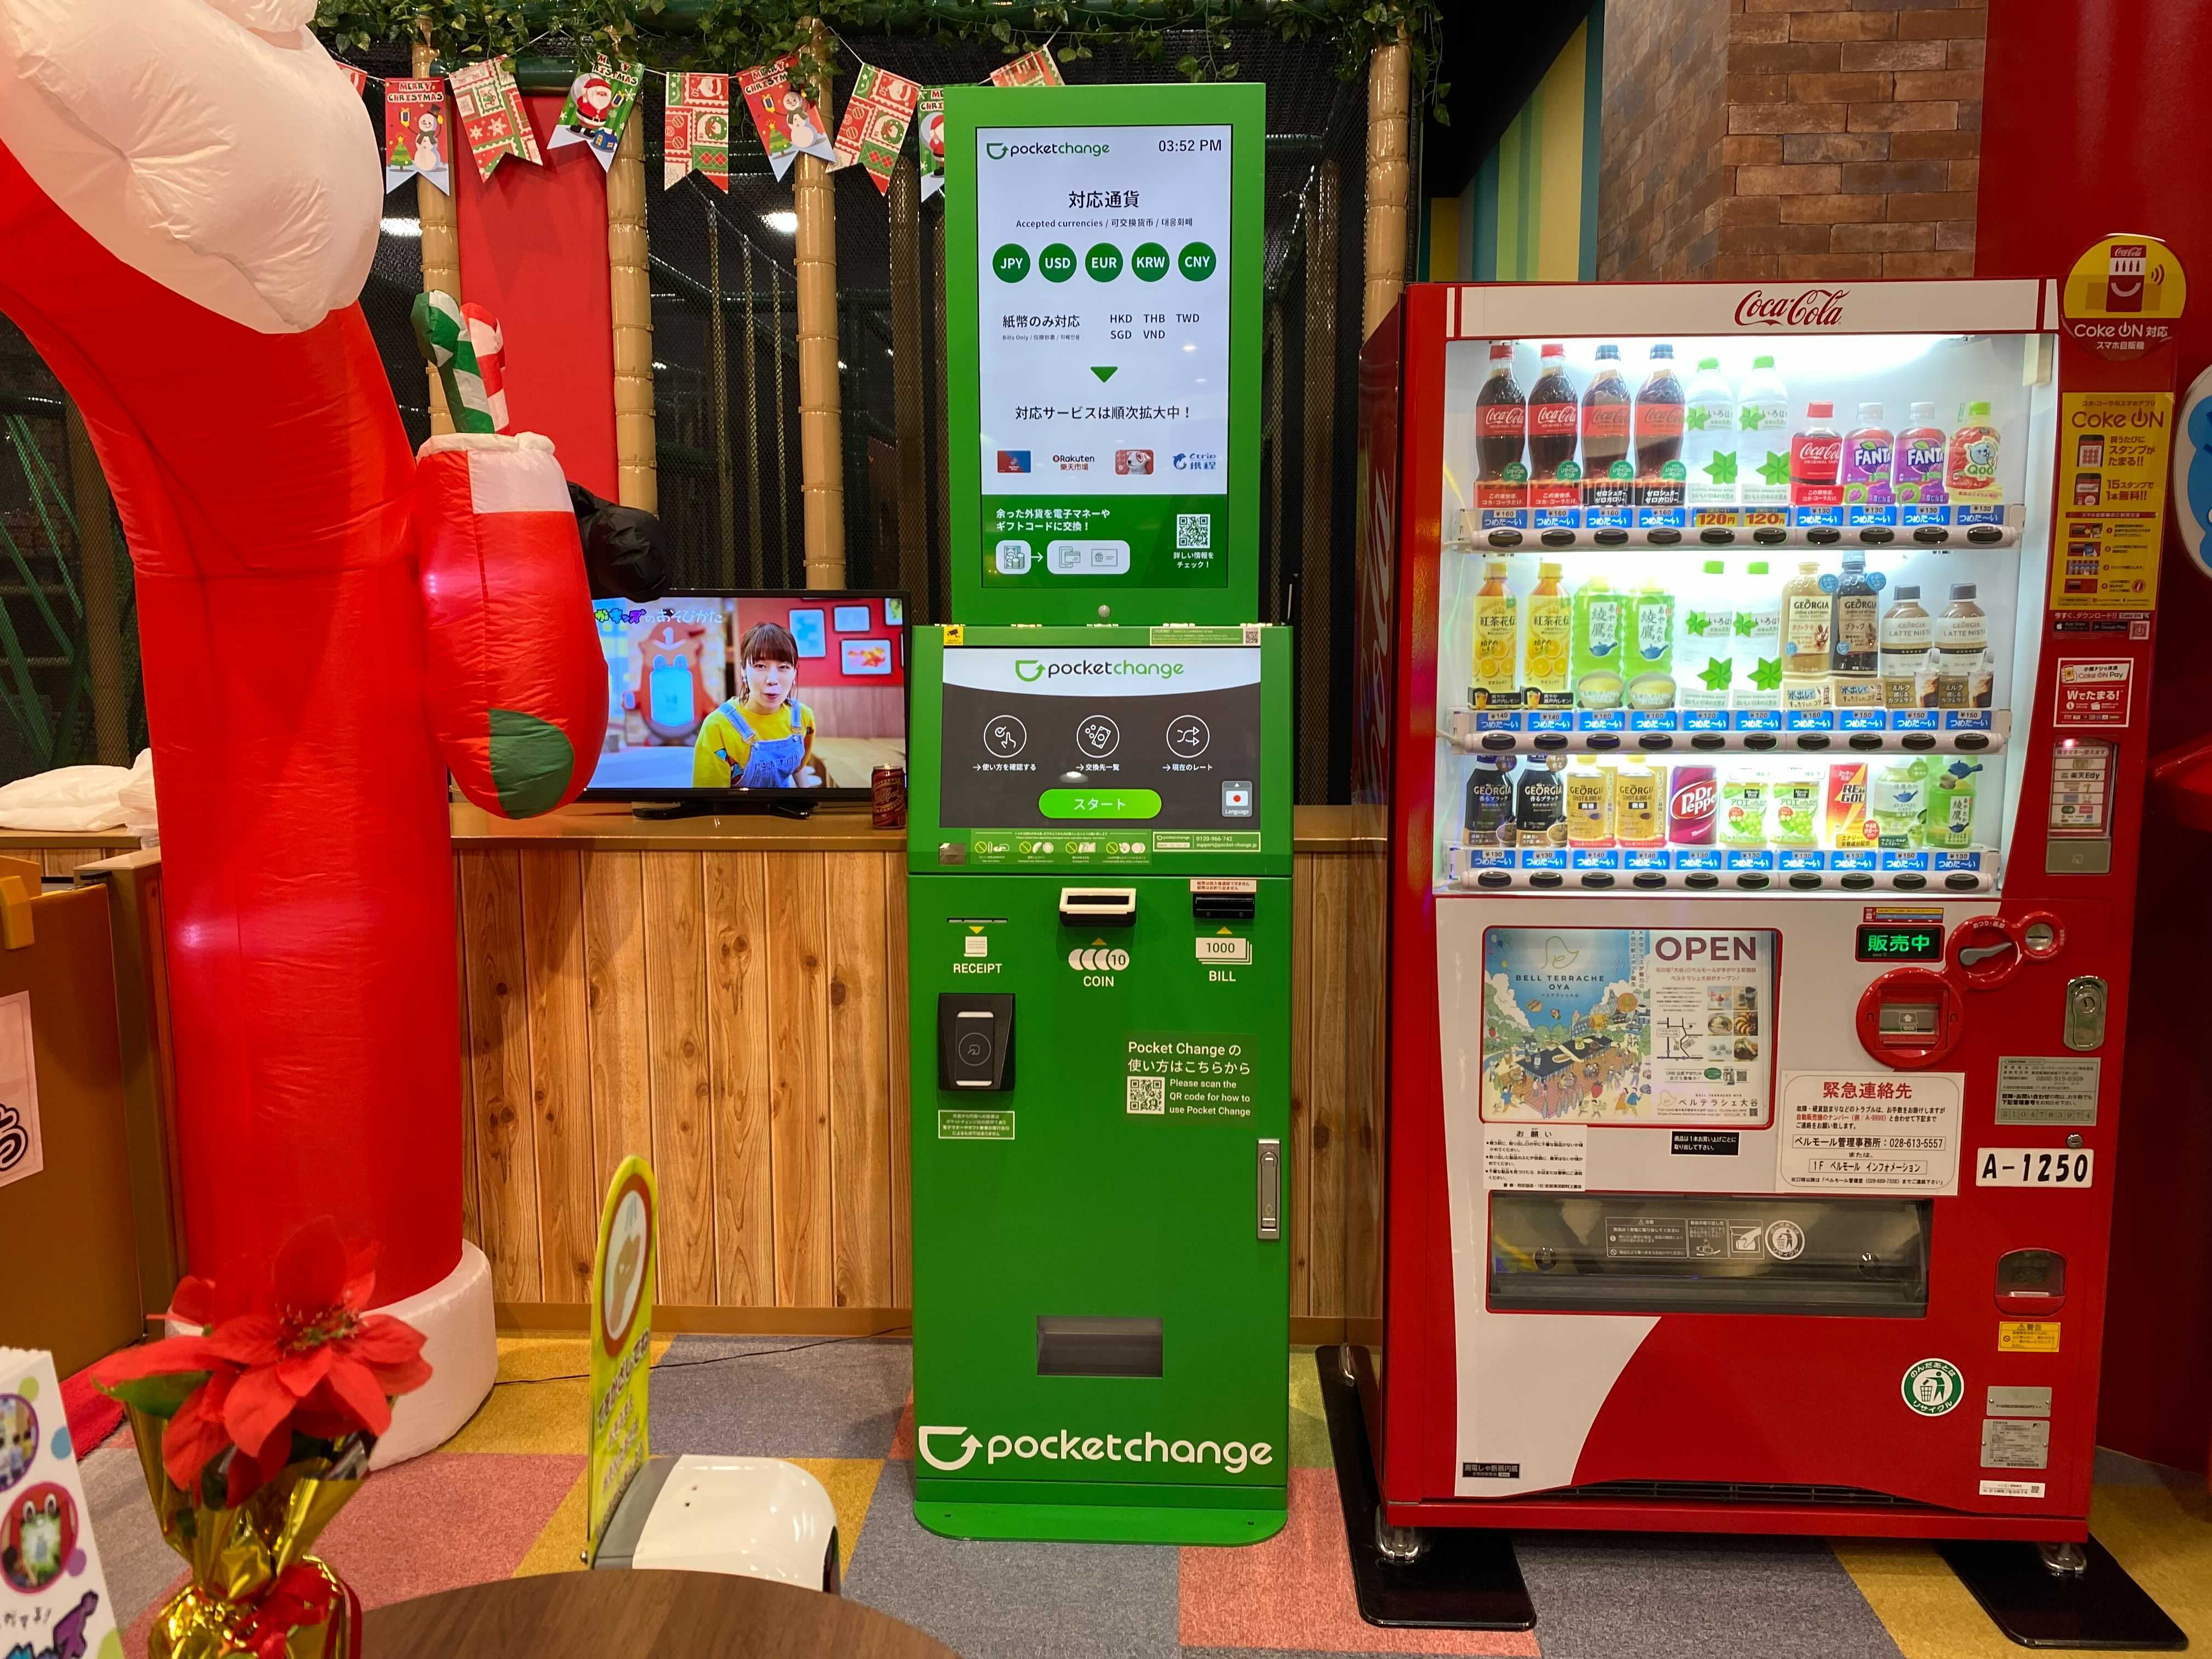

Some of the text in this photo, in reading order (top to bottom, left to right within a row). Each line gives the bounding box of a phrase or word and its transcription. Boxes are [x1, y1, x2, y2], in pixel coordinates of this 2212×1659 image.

[399, 82, 431, 91] MERRY
[388, 93, 443, 101] CHRISTMAS
[1010, 142, 1110, 157] pocketchange
[1159, 139, 1222, 152] 03:52 PM
[1068, 190, 1140, 209] 対応通貨
[1016, 219, 1055, 229] Accepted
[1058, 219, 1103, 228] currencies
[2115, 247, 2142, 256] Coca-Cola
[1000, 256, 1210, 270] JPY USD EUR KRW CNY
[1734, 290, 1851, 326] Coca-Cola
[1002, 314, 1080, 329] 紙幣のみ対応
[1110, 313, 1199, 324] HKD THB TWD
[2074, 321, 2168, 337] Coke ON 対応
[1110, 330, 1165, 340] SGD VND
[2097, 341, 2145, 349] スマホ自販機
[1015, 406, 1190, 420] 対応サービスは順次拡大中！
[1486, 408, 1525, 425] Coca-Cola
[1538, 407, 1576, 424] Coca-Cola
[2072, 408, 2164, 428] Coke ON
[2111, 436, 2146, 444] 買うたびに
[2109, 445, 2155, 455] スタンプが
[1060, 454, 1095, 463] Rakuten
[1189, 453, 1216, 461] Ctrip
[1967, 465, 1994, 475] Qoo
[2107, 479, 2154, 489] 15スタンプで
[996, 509, 1110, 519] 余った外貨を電子マネーや
[1699, 514, 1735, 524] 120円
[1746, 514, 1785, 524] 120円
[996, 521, 1089, 532] ギフトコードに交換！
[1794, 599, 1829, 610] GEORGIA
[1592, 607, 1607, 638] 綾鷹
[1607, 604, 1616, 640] あやたか
[1641, 609, 1657, 640] 綾鷹
[1657, 605, 1666, 641] あやたか
[1048, 660, 1184, 679] pocketchange
[982, 763, 1036, 771] 使い方を確認する
[1085, 763, 1120, 771] 交換先一覧
[1172, 763, 1212, 771] 現在のレート
[1474, 786, 1511, 795] GEORGIA
[1525, 786, 1562, 795] GEORGIA
[1695, 786, 1712, 799] Dr
[1074, 797, 1126, 811] スタート
[1224, 808, 1249, 816] Language
[1953, 801, 1962, 822] 綾鷹
[1206, 943, 1235, 953] 1000
[1868, 934, 1930, 951] 販売中
[1655, 936, 1757, 962] OPEN
[1111, 954, 1126, 966] 10
[953, 963, 1002, 974] RECEIPT
[1083, 976, 1114, 987] COIN
[1209, 971, 1236, 982] BILL
[1128, 1041, 1241, 1057] Pocket Change の
[1128, 1059, 1250, 1075] 使い方はこちらから
[1170, 1079, 1197, 1088] Please
[1223, 1080, 1237, 1088] the
[1823, 1081, 1912, 1099] 緊急連絡先
[1170, 1092, 1250, 1102] QR code for how to
[1679, 1098, 1758, 1107] ベルテラシェ大谷
[1187, 1106, 1215, 1115] Pocket
[1217, 1107, 1251, 1117] Change
[1814, 1161, 1920, 1172] 1F ベルモール インフォメーション
[1982, 1154, 2088, 1182] A-1250
[1911, 1361, 1956, 1378] のんだあとは
[1912, 1401, 1953, 1414] リサイクル
[989, 1430, 1273, 1474] pocketchange
